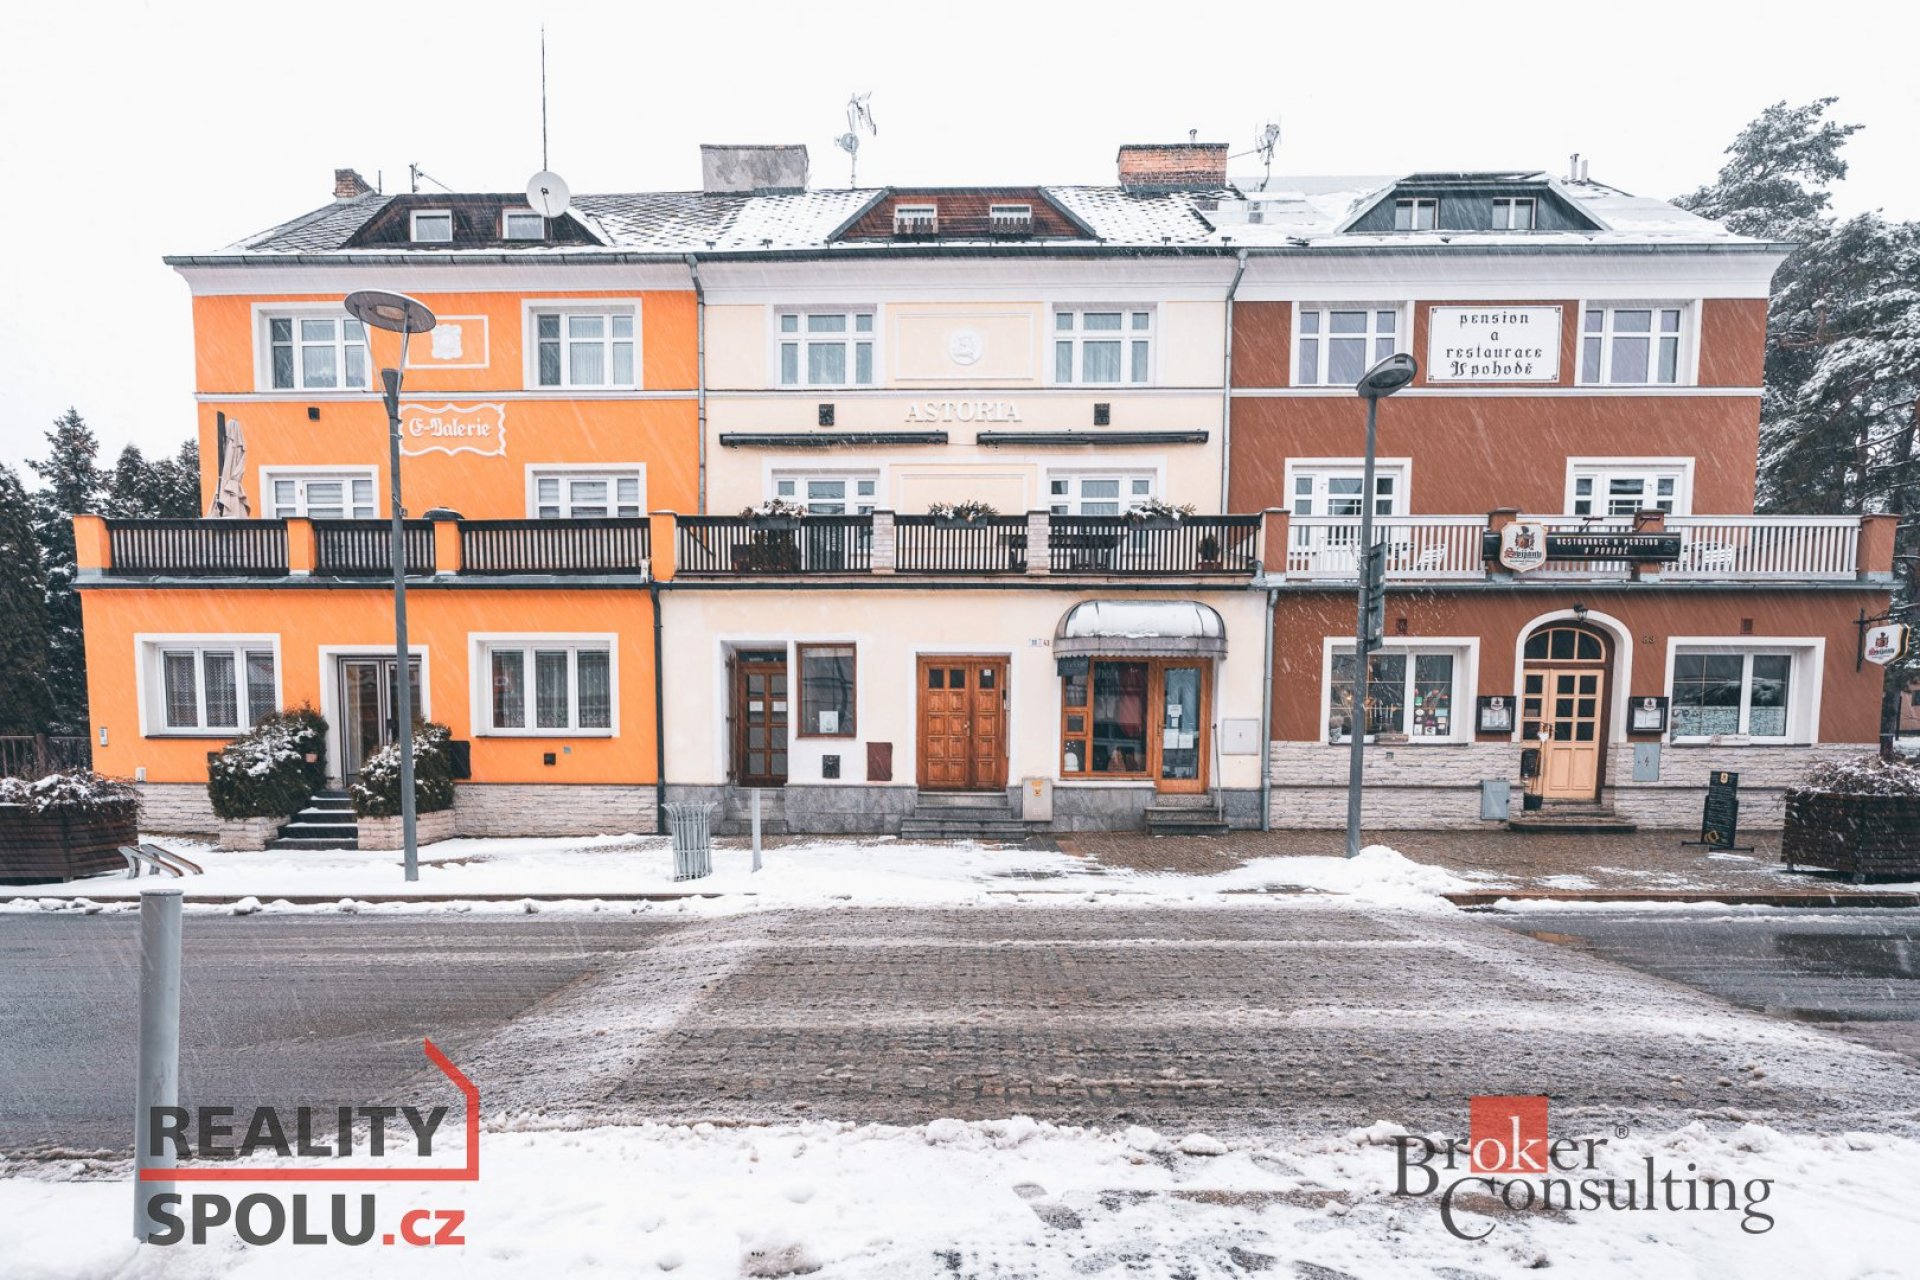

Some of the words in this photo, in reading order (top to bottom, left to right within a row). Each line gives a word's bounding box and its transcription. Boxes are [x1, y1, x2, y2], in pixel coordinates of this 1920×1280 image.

[1460, 311, 1529, 327] pension
[1491, 331, 1499, 341] a
[1446, 343, 1542, 359] restaurace
[1471, 360, 1533, 378] pohodě
[904, 400, 1023, 422] ASTORIA
